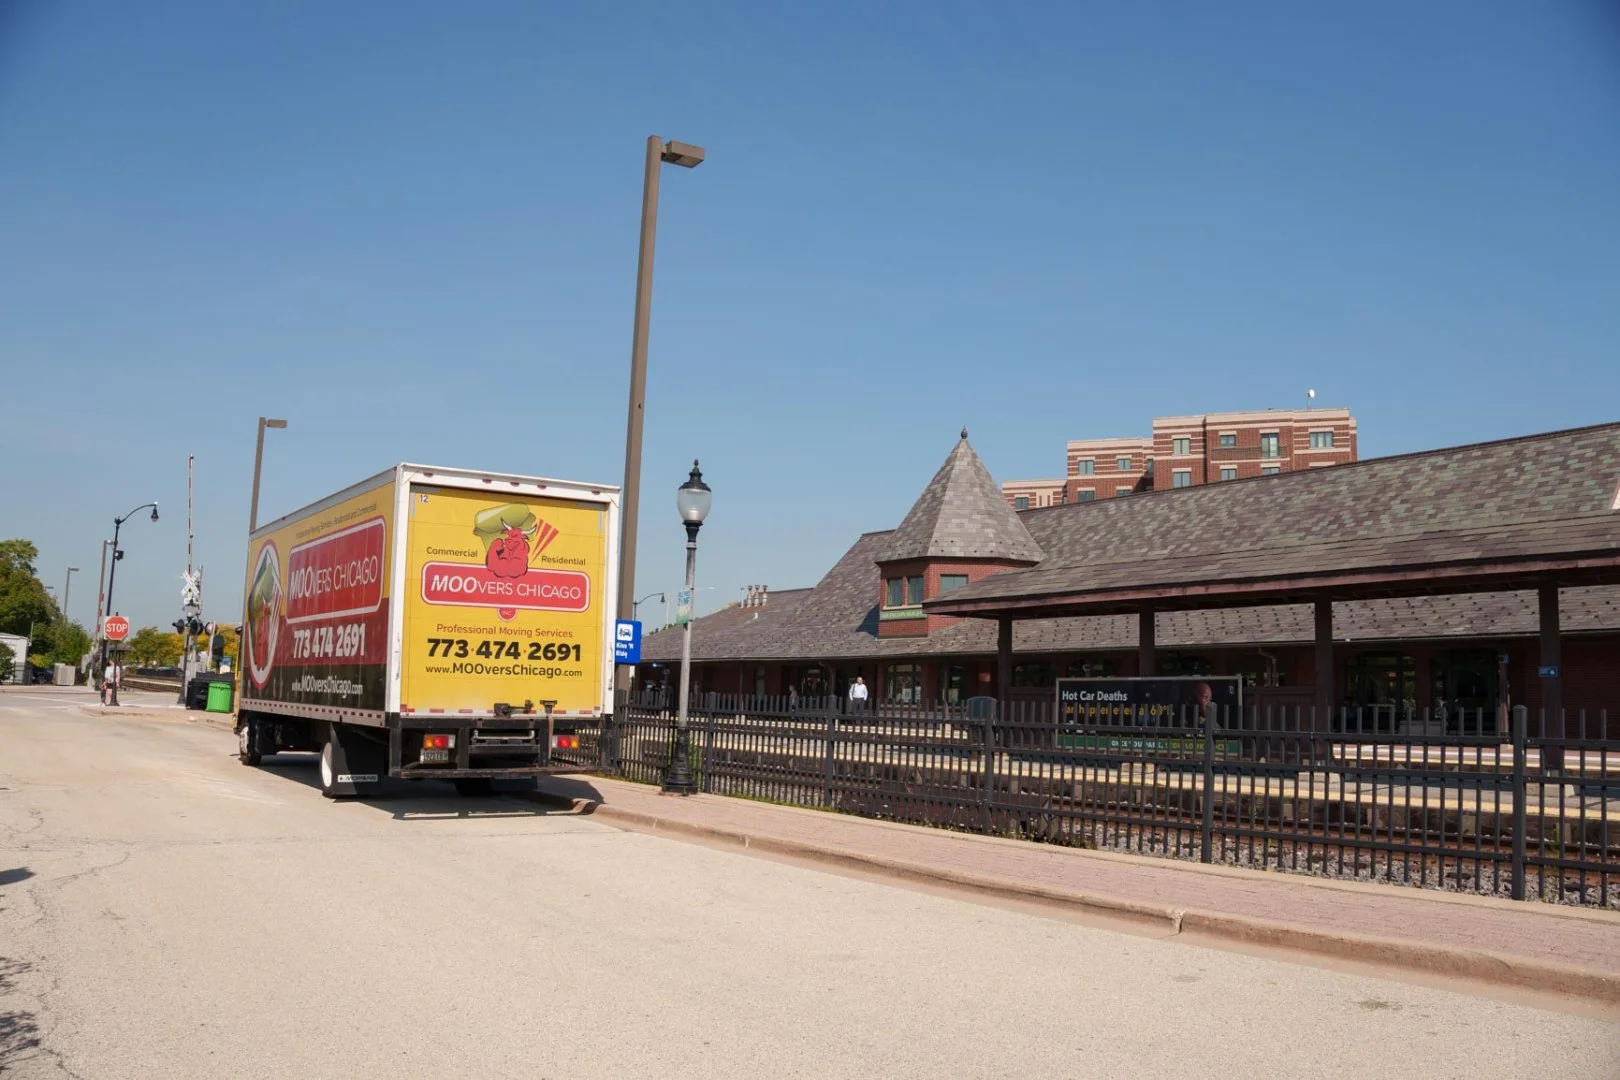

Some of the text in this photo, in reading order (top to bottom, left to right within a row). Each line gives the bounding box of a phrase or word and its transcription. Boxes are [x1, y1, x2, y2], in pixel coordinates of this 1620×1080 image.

[420, 495, 429, 503] 12
[426, 546, 478, 558] Commercial
[541, 555, 586, 566] Residential
[333, 555, 379, 591] CHICAGO
[430, 574, 581, 600] MOOVERS CHICAGO
[106, 623, 128, 633] STOP
[436, 623, 573, 639] Professional Moving Services
[425, 662, 583, 679] www.MOOversChicago.com
[1062, 690, 1128, 701] Hot Car Deaths
